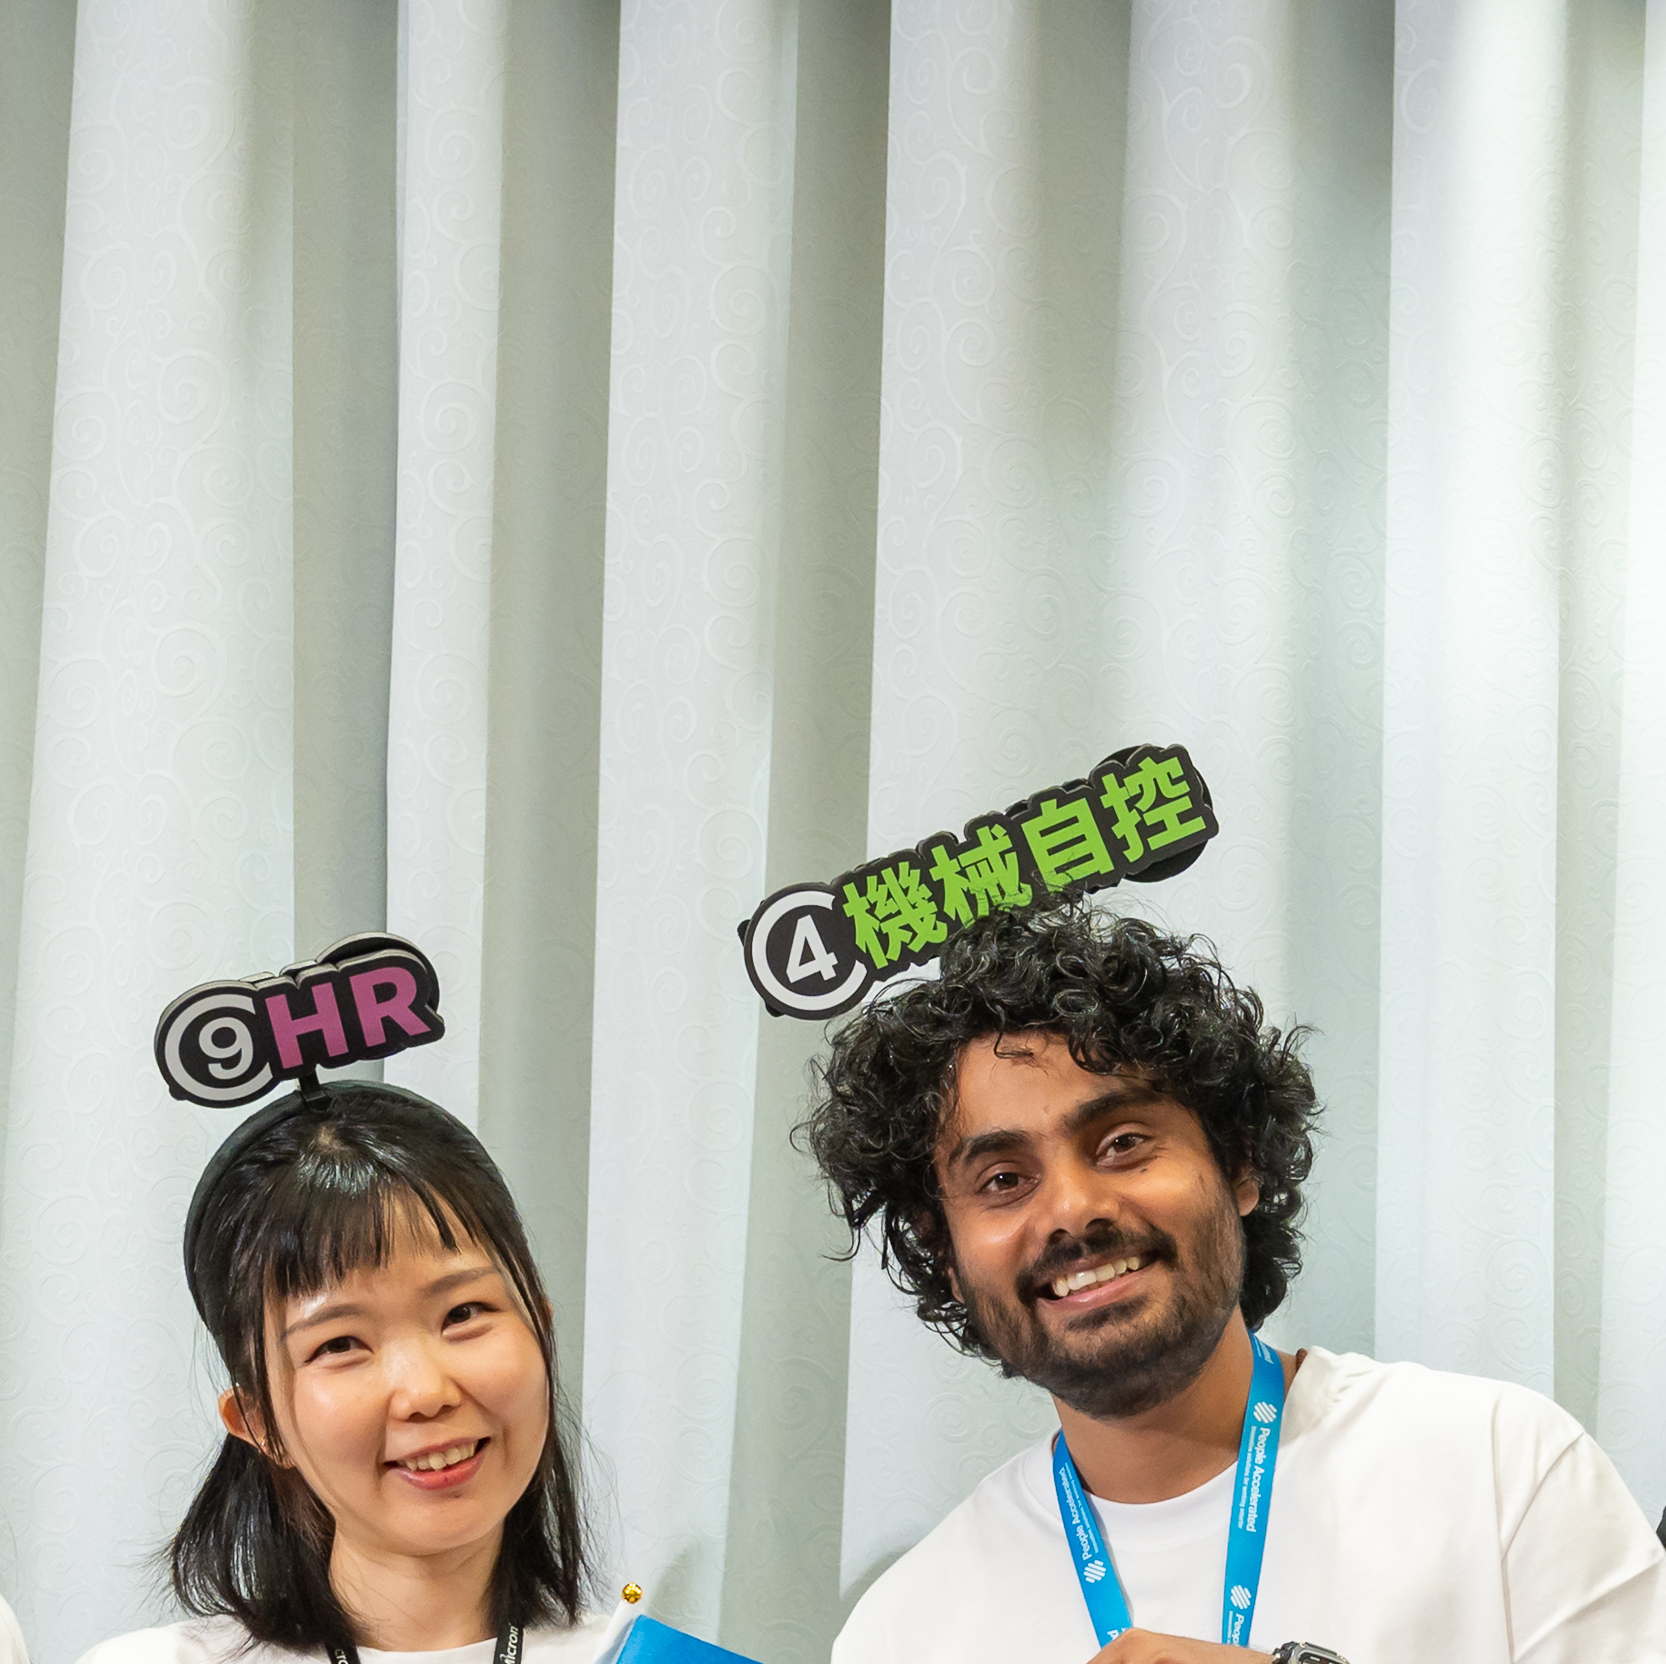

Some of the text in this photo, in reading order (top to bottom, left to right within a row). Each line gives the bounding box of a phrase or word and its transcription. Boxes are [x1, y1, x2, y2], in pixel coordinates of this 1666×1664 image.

[1058, 1467, 1093, 1561] People Accelerated
[1244, 1427, 1272, 1533] People Accelerated
